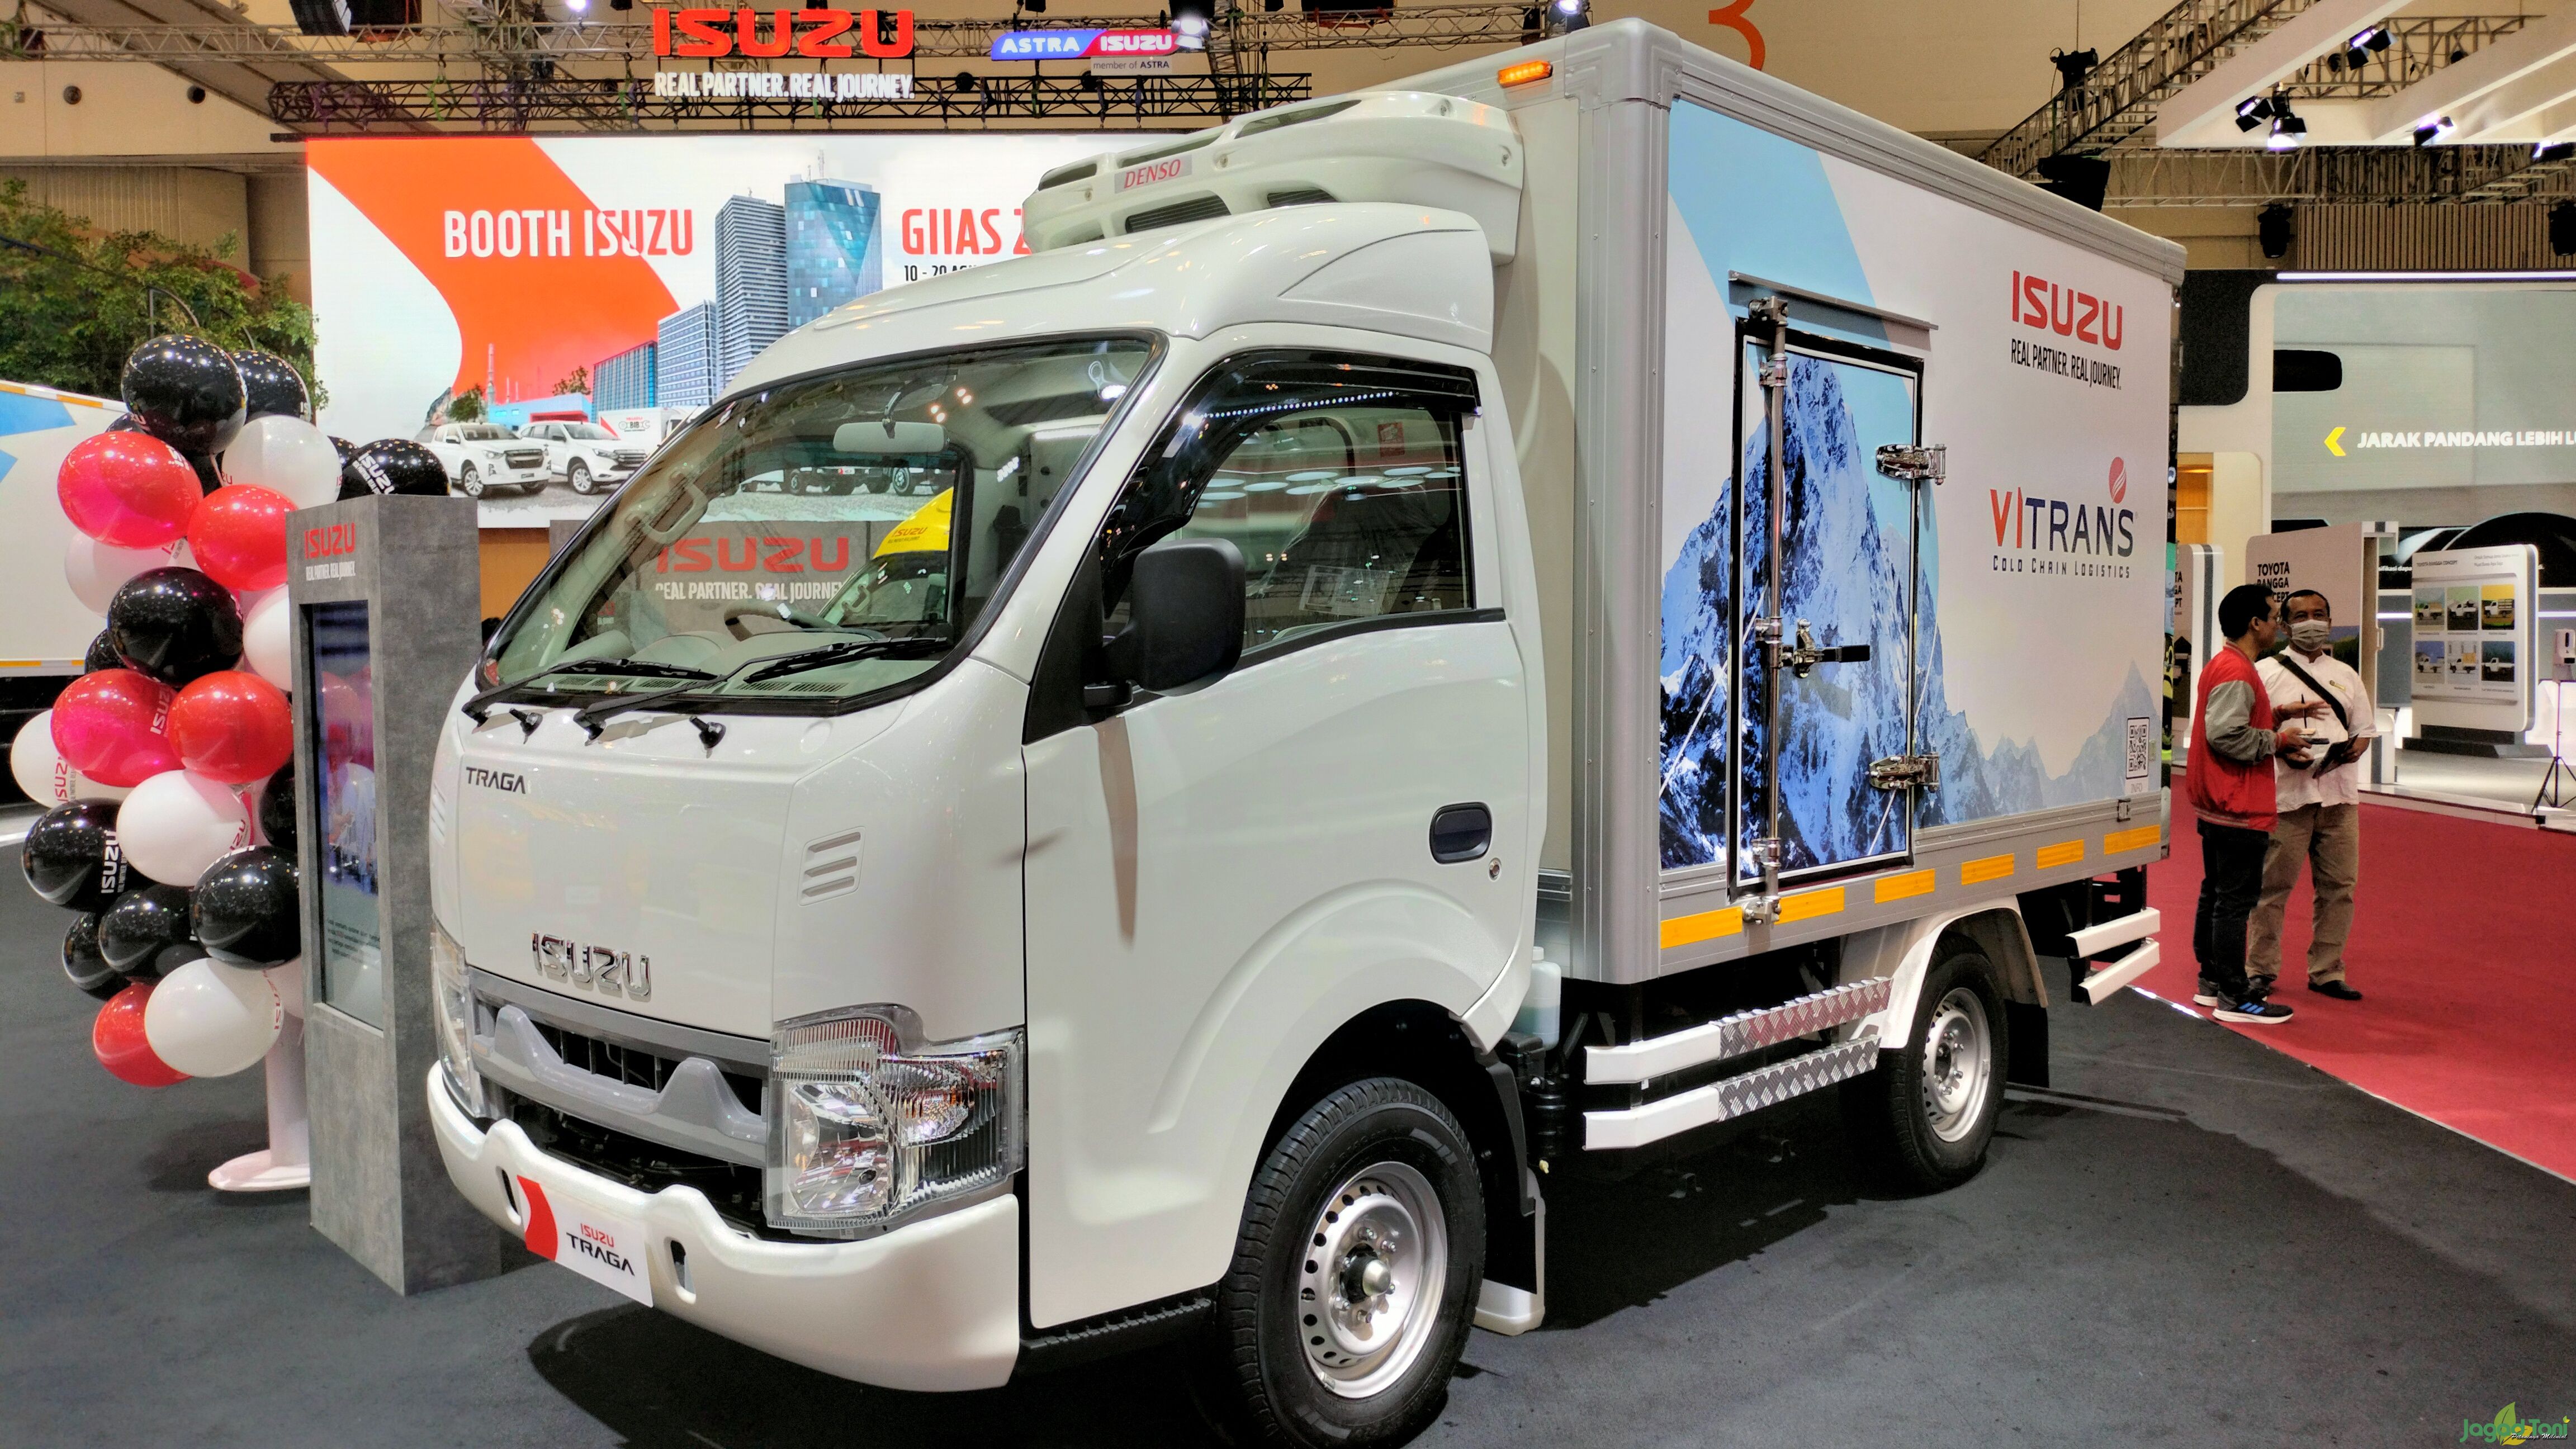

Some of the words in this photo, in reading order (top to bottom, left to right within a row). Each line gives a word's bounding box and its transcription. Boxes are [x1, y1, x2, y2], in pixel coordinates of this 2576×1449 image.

[653, 8, 914, 58] ISUZU
[1001, 37, 1079, 53] ASTRA
[1101, 35, 1172, 51] ISUZU
[654, 72, 700, 97] REAL
[702, 72, 789, 97] PARTNER.
[789, 73, 836, 98] REAL
[836, 73, 915, 102] JOURNEY.
[1124, 159, 1181, 189] DENSO
[444, 210, 570, 258] BOOTH
[584, 209, 693, 257] ISUZU
[902, 209, 1000, 255] GIIAS
[905, 265, 918, 281] 10
[2012, 270, 2123, 351] ISUZU
[2011, 338, 2030, 367] REAL
[2033, 344, 2069, 377] PARTNER.
[2071, 354, 2089, 382] REAL
[2090, 359, 2122, 390] JOURNEY.
[2357, 432, 2421, 448] JARAK
[2424, 432, 2513, 447] PANDANG
[2516, 431, 2562, 446] LEBIH
[892, 527, 928, 537] ISUZU
[1990, 487, 2134, 557] VITRANS
[305, 522, 356, 559] ISUZU
[655, 537, 849, 574] ISUZU
[1993, 555, 2023, 572] COLD
[2032, 558, 2067, 575] CHAIN
[2075, 561, 2129, 578] LOGISTICS
[2257, 561, 2290, 577] TOYOTA
[688, 581, 752, 600] PARTNER.
[466, 766, 526, 794] TRAGA
[101, 831, 119, 893] ISUZU
[532, 930, 651, 997] ISUZU
[580, 1223, 614, 1248] ISUZU
[566, 1232, 635, 1277] TRAGA
